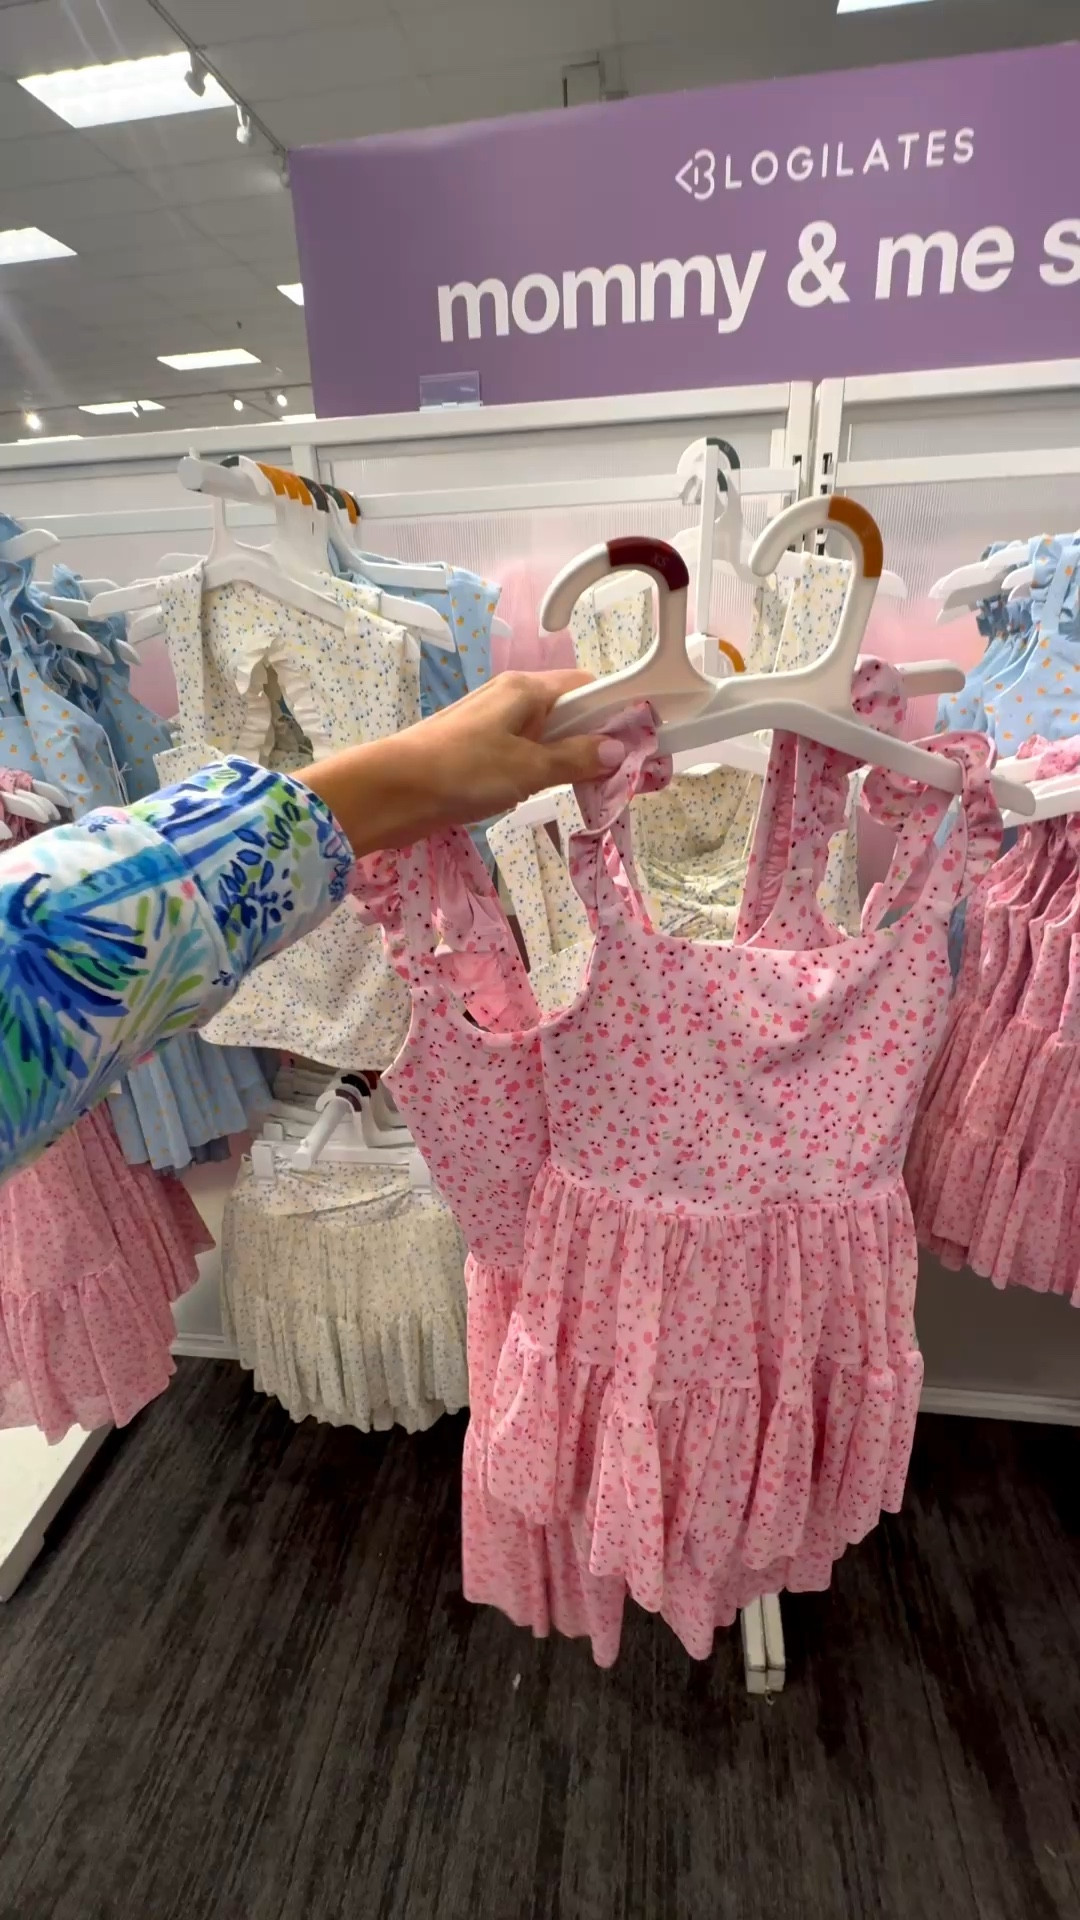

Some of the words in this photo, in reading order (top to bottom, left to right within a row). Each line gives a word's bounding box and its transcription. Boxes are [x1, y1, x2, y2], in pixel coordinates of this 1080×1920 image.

[674, 127, 976, 201] BLOGILATES
[437, 249, 767, 342] mommy
[786, 219, 851, 308] &
[874, 225, 1015, 300] me
